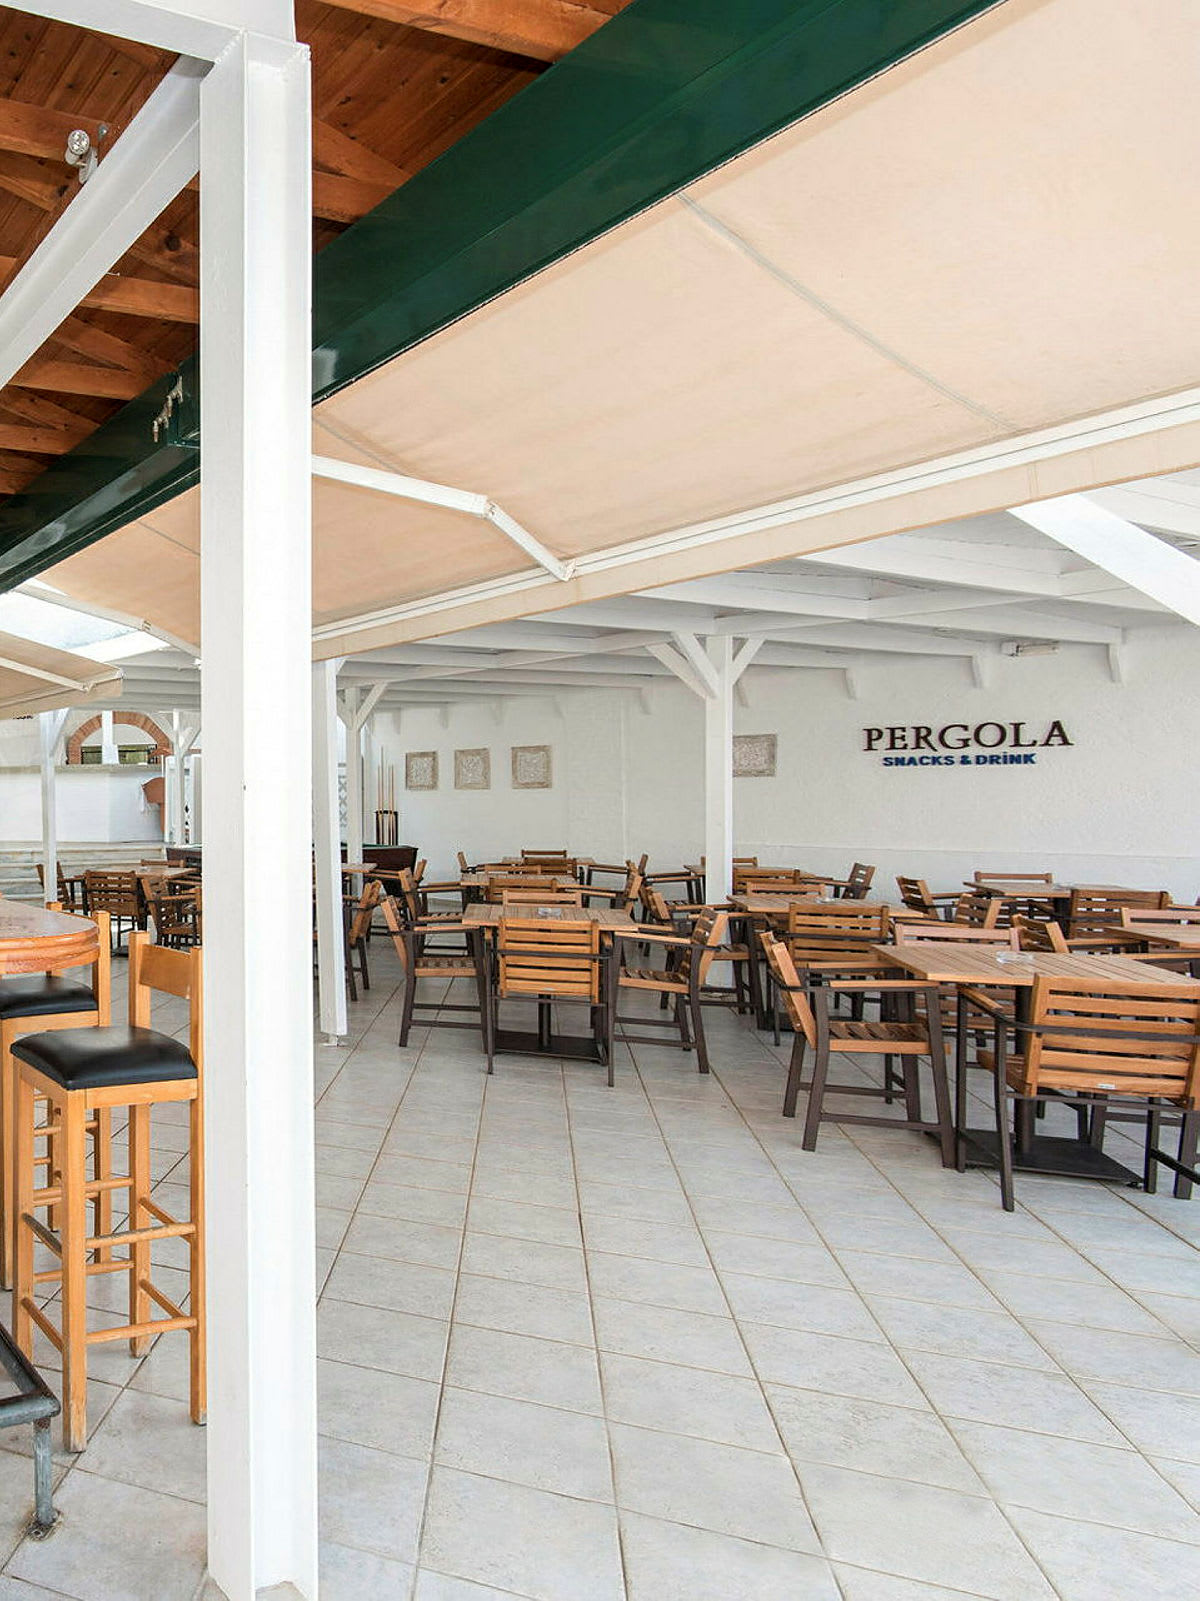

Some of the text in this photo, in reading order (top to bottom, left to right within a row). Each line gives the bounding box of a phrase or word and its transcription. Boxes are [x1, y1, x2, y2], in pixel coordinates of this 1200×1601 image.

[862, 720, 1074, 752] PERGOLA
[882, 756, 955, 766] SNACKS
[960, 755, 972, 765] &
